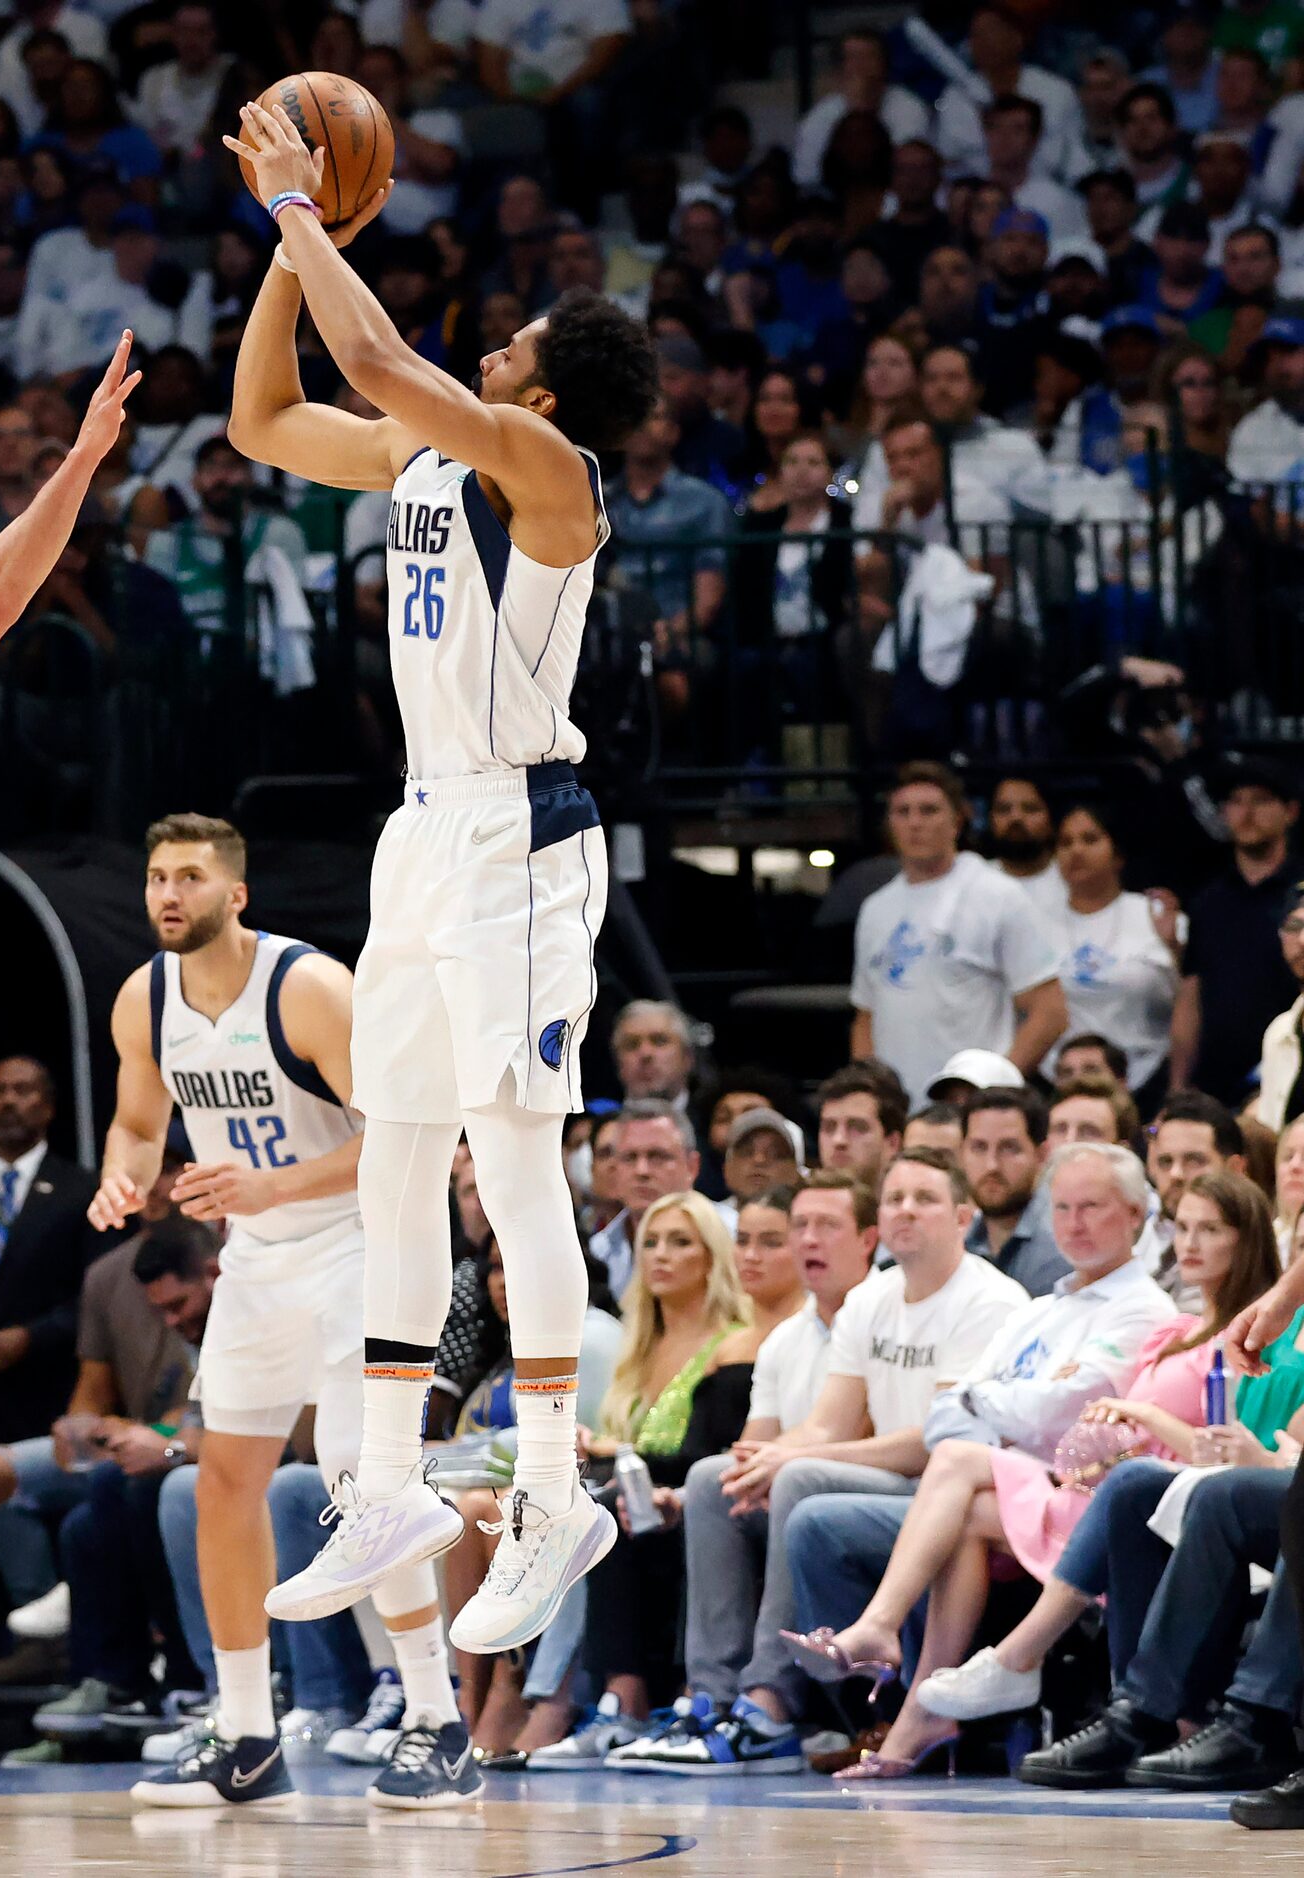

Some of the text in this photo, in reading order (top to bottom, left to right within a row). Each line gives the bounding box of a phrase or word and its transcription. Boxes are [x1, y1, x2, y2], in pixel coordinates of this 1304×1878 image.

[388, 500, 453, 554] ALLAS
[403, 563, 446, 641] 26
[172, 1069, 274, 1109] DALLAS
[226, 1115, 300, 1170] 42
